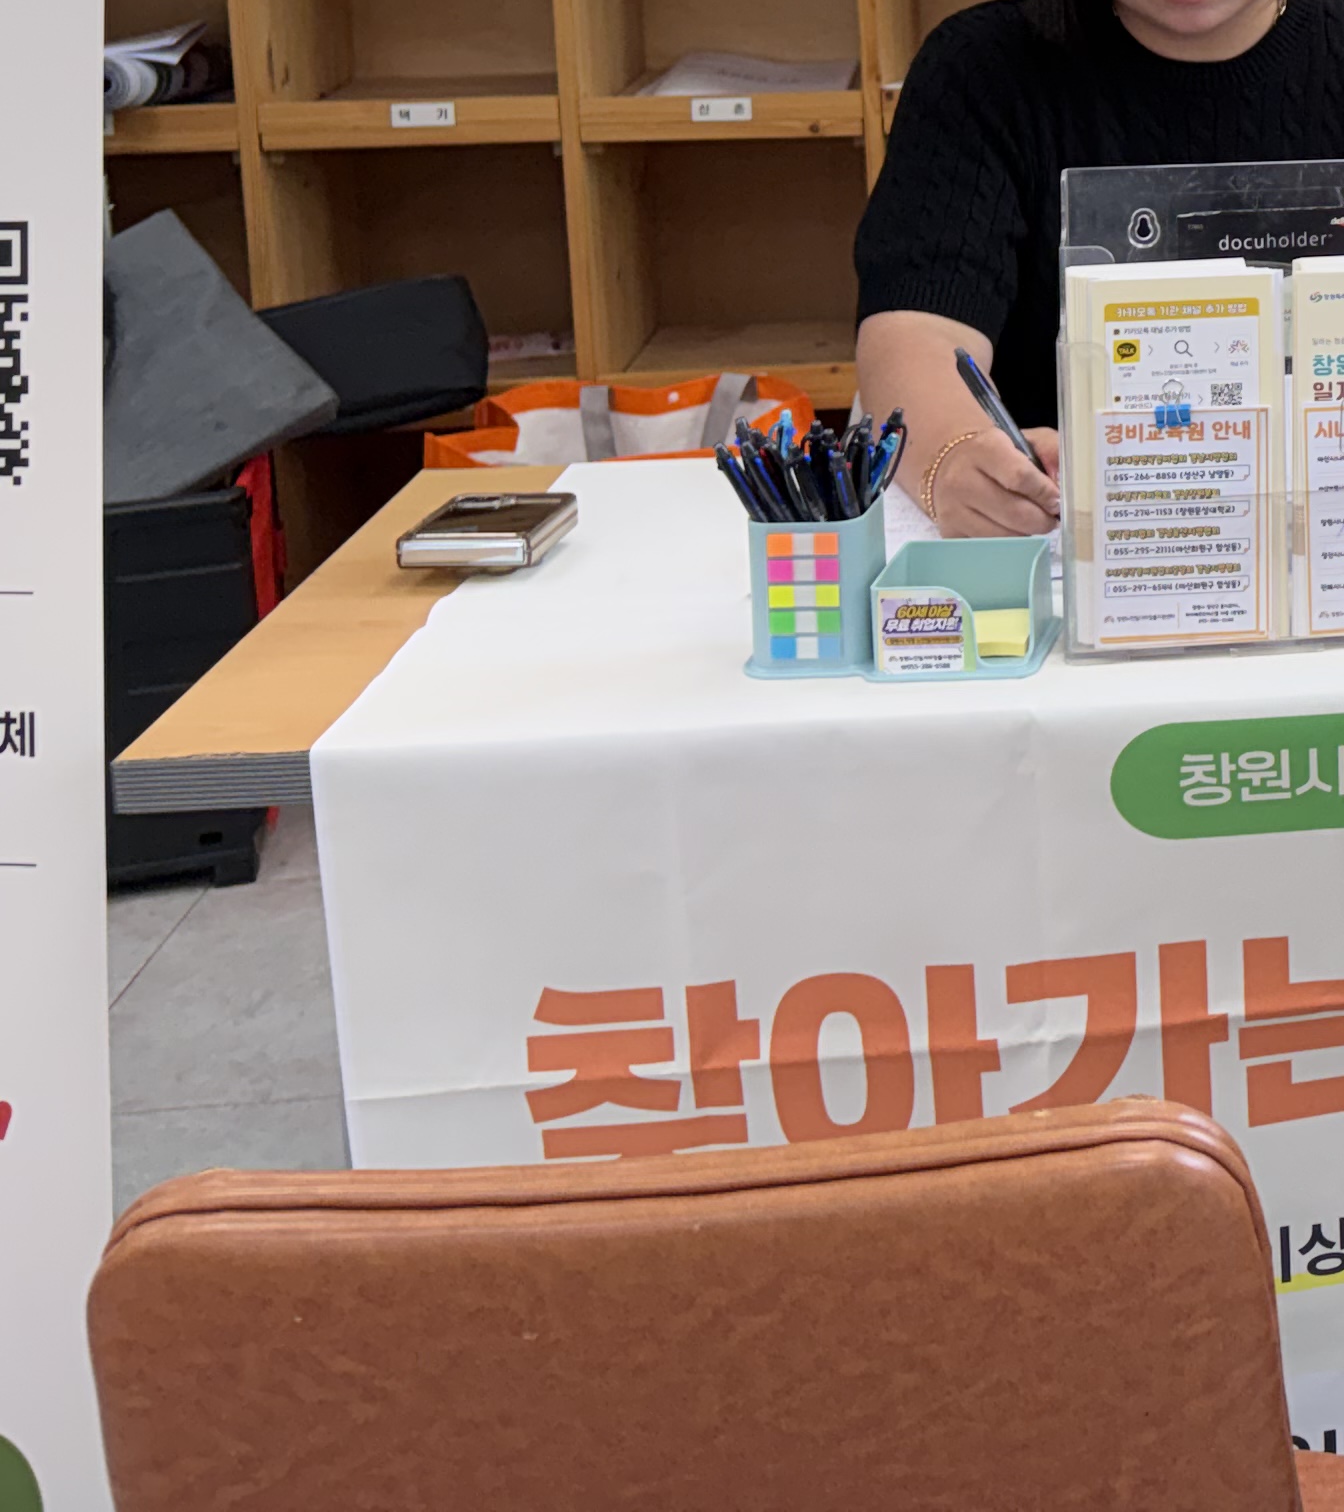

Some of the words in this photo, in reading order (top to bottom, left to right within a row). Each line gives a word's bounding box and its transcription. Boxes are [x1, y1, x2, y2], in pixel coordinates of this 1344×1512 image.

[1219, 233, 1327, 251] docuholder
[1104, 419, 1204, 444] 경비교육원
[1211, 419, 1251, 440] 안내
[897, 604, 928, 619] 60세
[0, 709, 36, 758] 체
